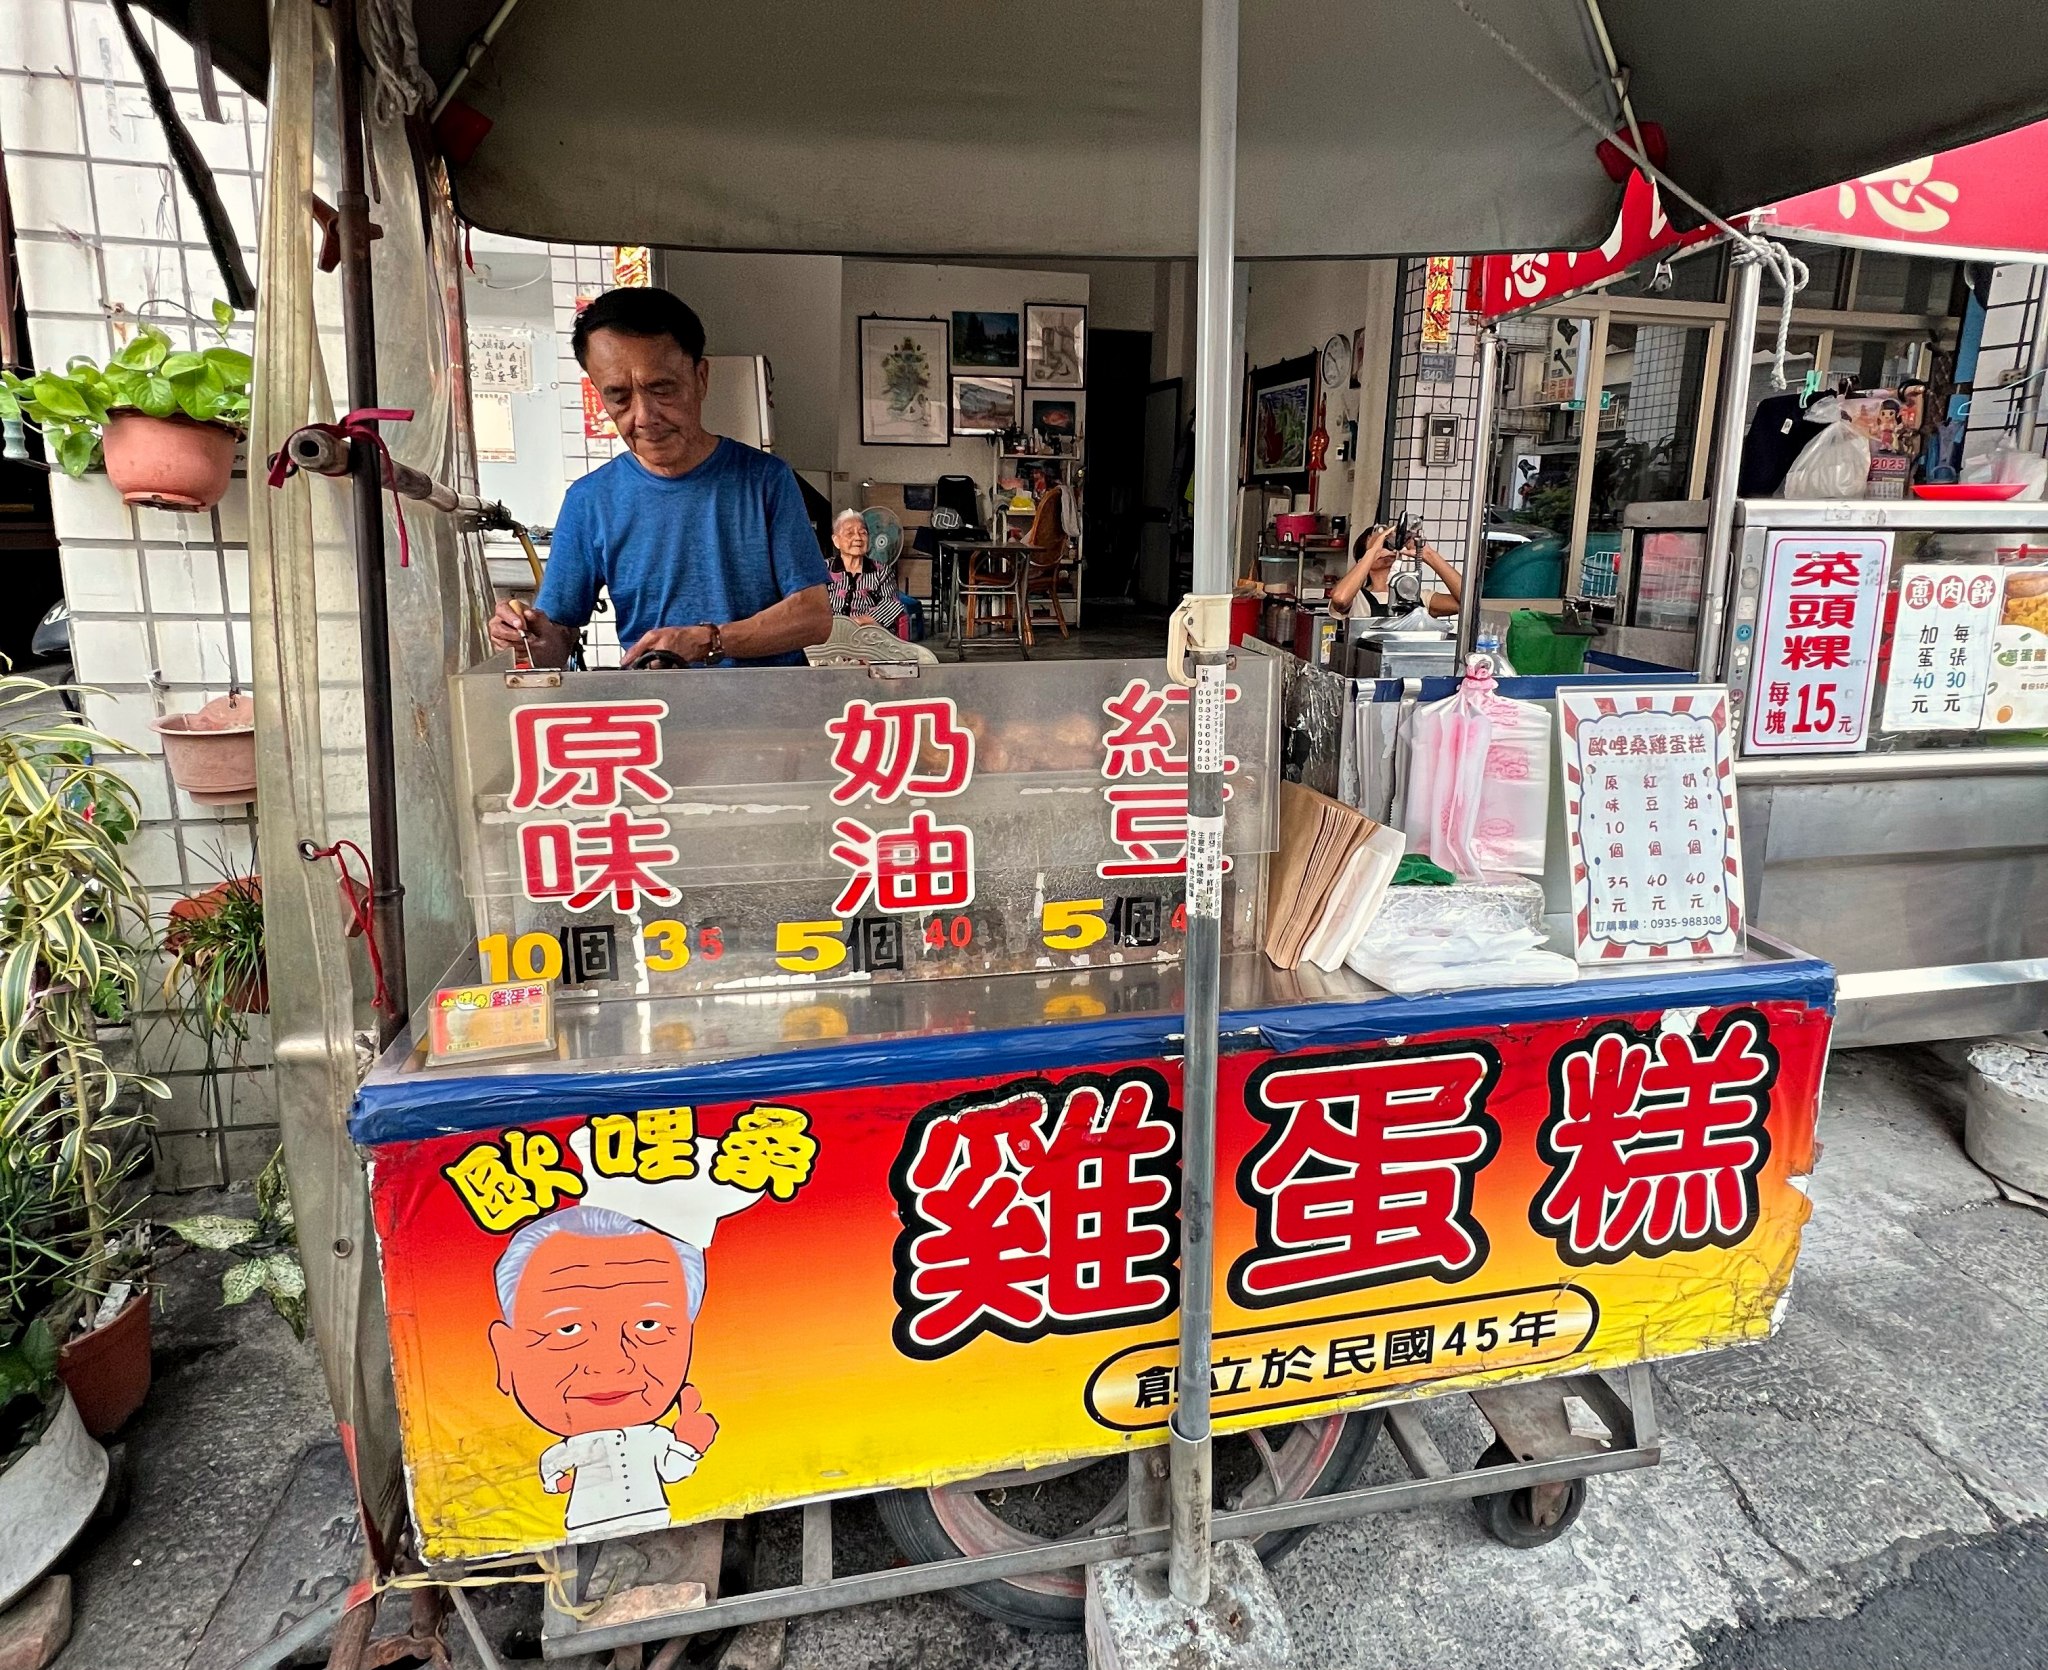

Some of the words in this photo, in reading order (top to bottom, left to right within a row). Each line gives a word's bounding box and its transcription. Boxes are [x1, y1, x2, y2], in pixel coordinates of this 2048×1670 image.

[1872, 457, 1906, 471] 2025
[1781, 551, 1862, 671] 菜頭粿
[1588, 733, 1707, 757] 歐哩桑雞蛋糕
[1764, 681, 1790, 735] 每塊
[508, 699, 683, 914] 原味
[825, 697, 976, 918] 奶油
[925, 916, 972, 949] 40
[445, 1105, 817, 1232] 歐哩桑
[899, 1016, 1775, 1352] 雞蛋糕
